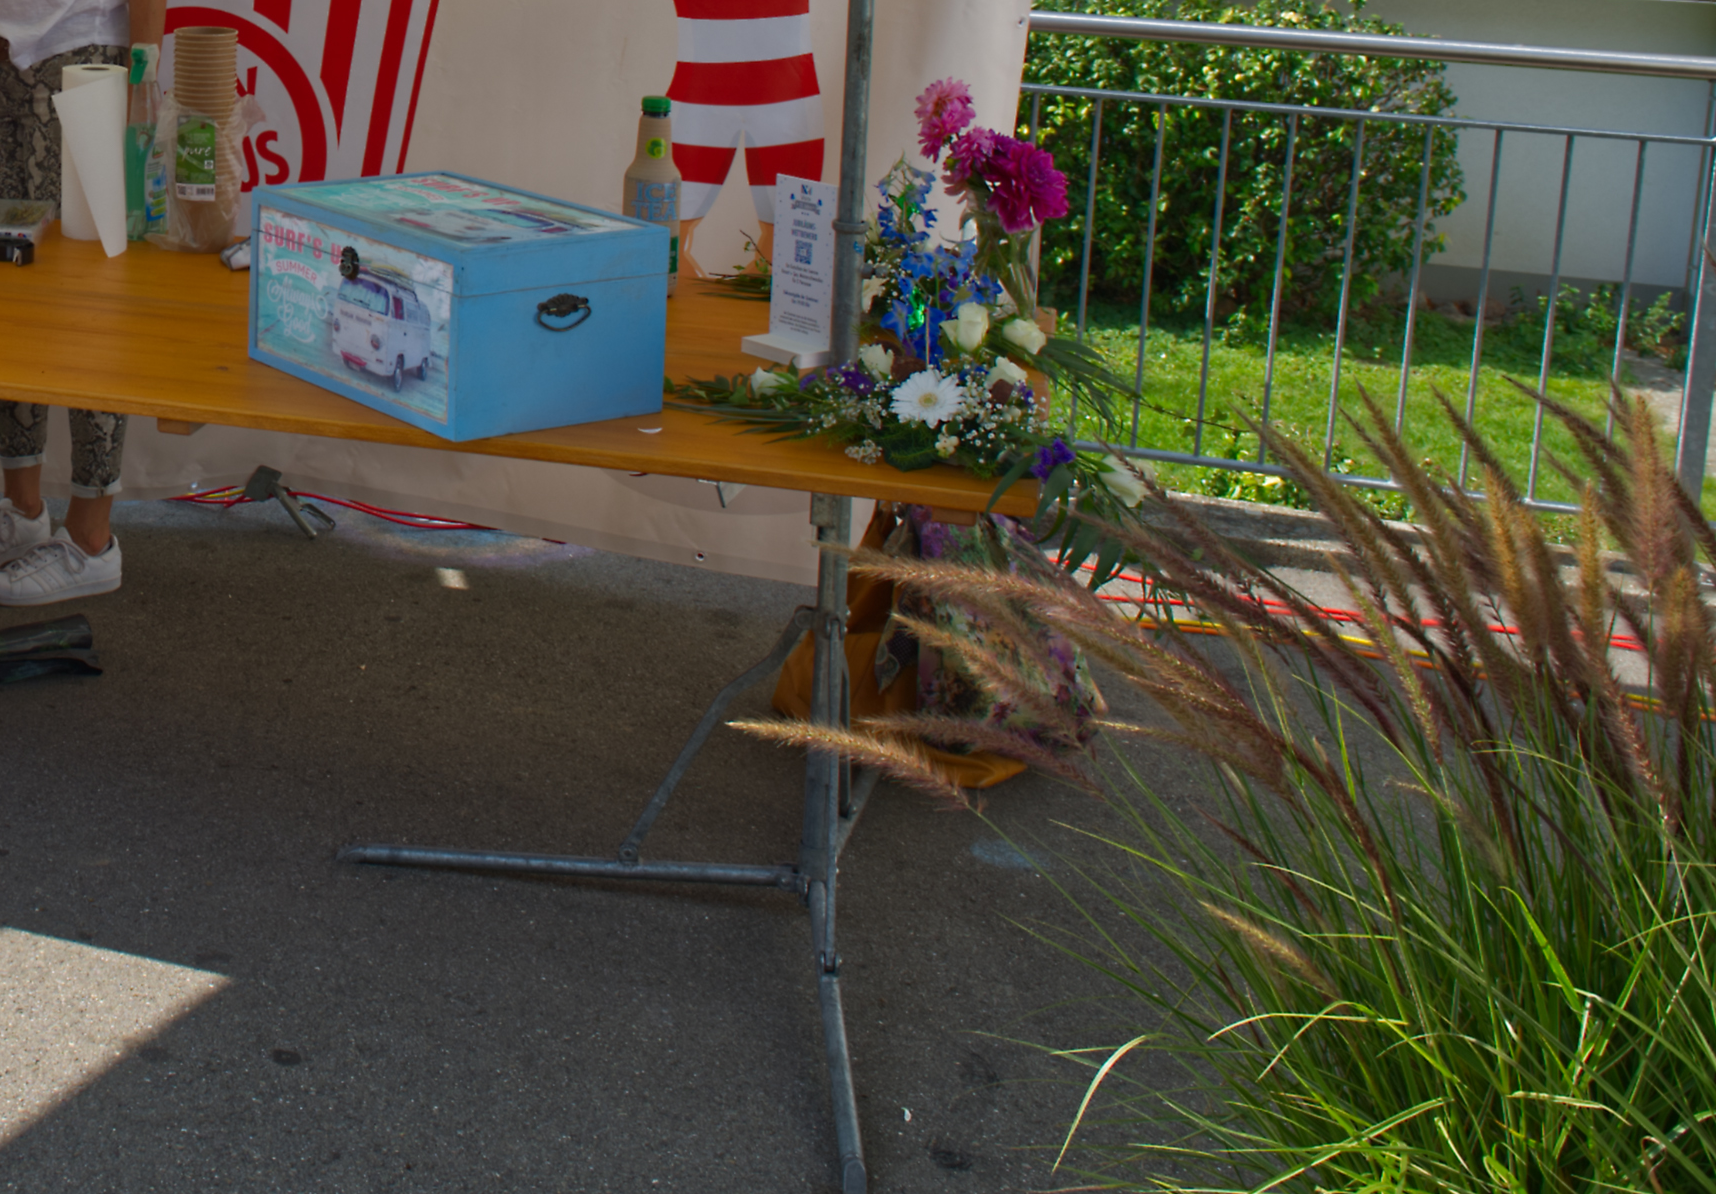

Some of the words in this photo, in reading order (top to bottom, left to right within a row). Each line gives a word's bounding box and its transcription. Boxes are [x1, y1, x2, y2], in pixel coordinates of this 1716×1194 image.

[635, 182, 677, 202] ICE
[631, 200, 678, 221] TEA
[263, 221, 323, 260] SURF'S
[330, 242, 343, 265] U
[275, 260, 318, 285] SUMMER
